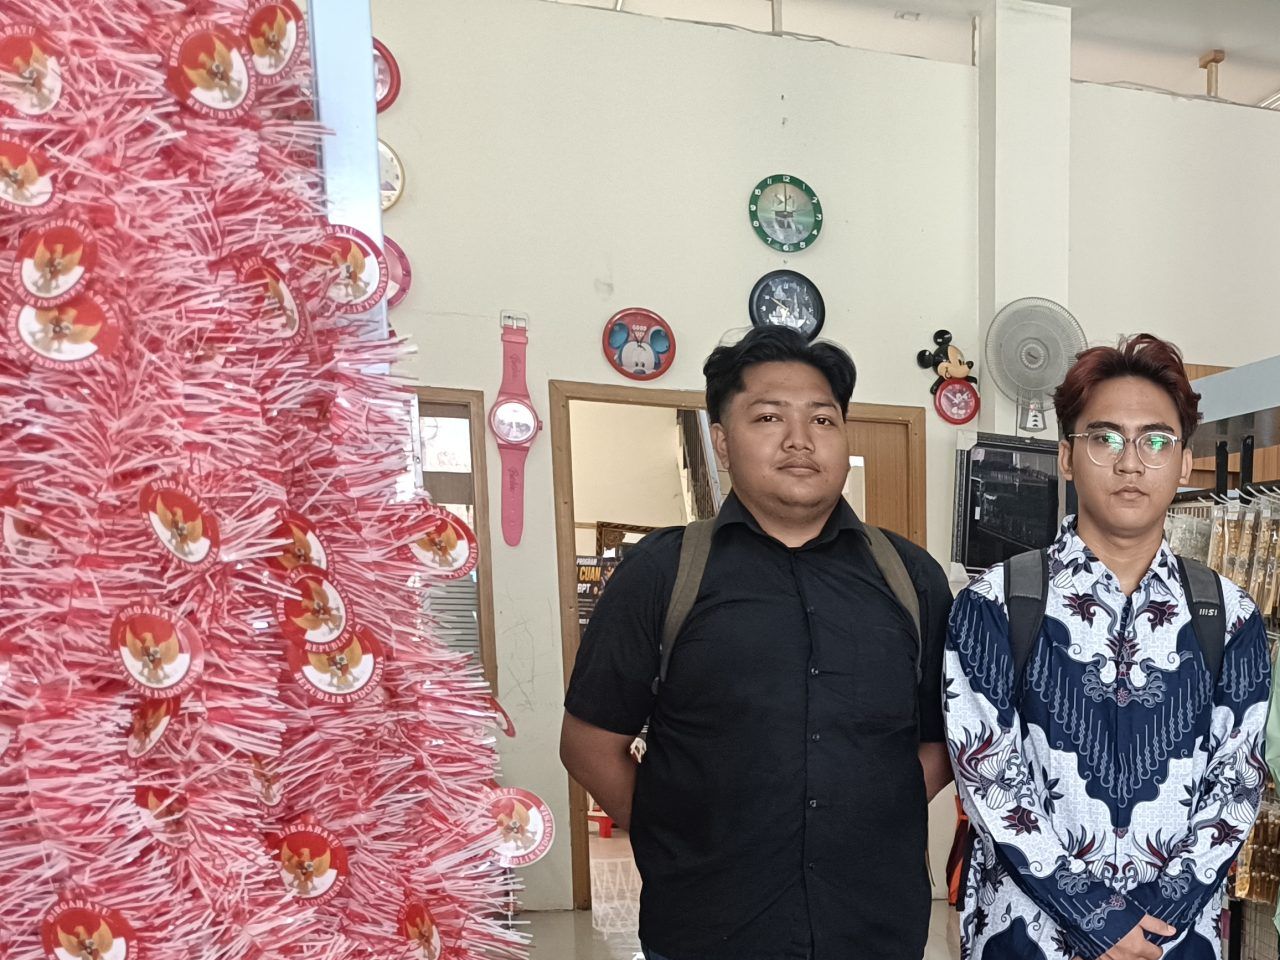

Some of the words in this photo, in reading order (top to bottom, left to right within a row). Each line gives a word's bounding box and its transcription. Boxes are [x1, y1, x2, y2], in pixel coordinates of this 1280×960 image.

[169, 20, 216, 67] DIRGAHAYU
[187, 97, 245, 120] REPUBLIK
[580, 566, 600, 582] CUAN
[304, 631, 350, 653] REPUBLIK
[294, 672, 344, 704] REPUBLIK
[346, 656, 384, 703] INDONESIA
[278, 823, 341, 849] DIRGAHAYU
[298, 876, 346, 907] INDONESIA
[46, 900, 113, 923] DIRGAHAYU
